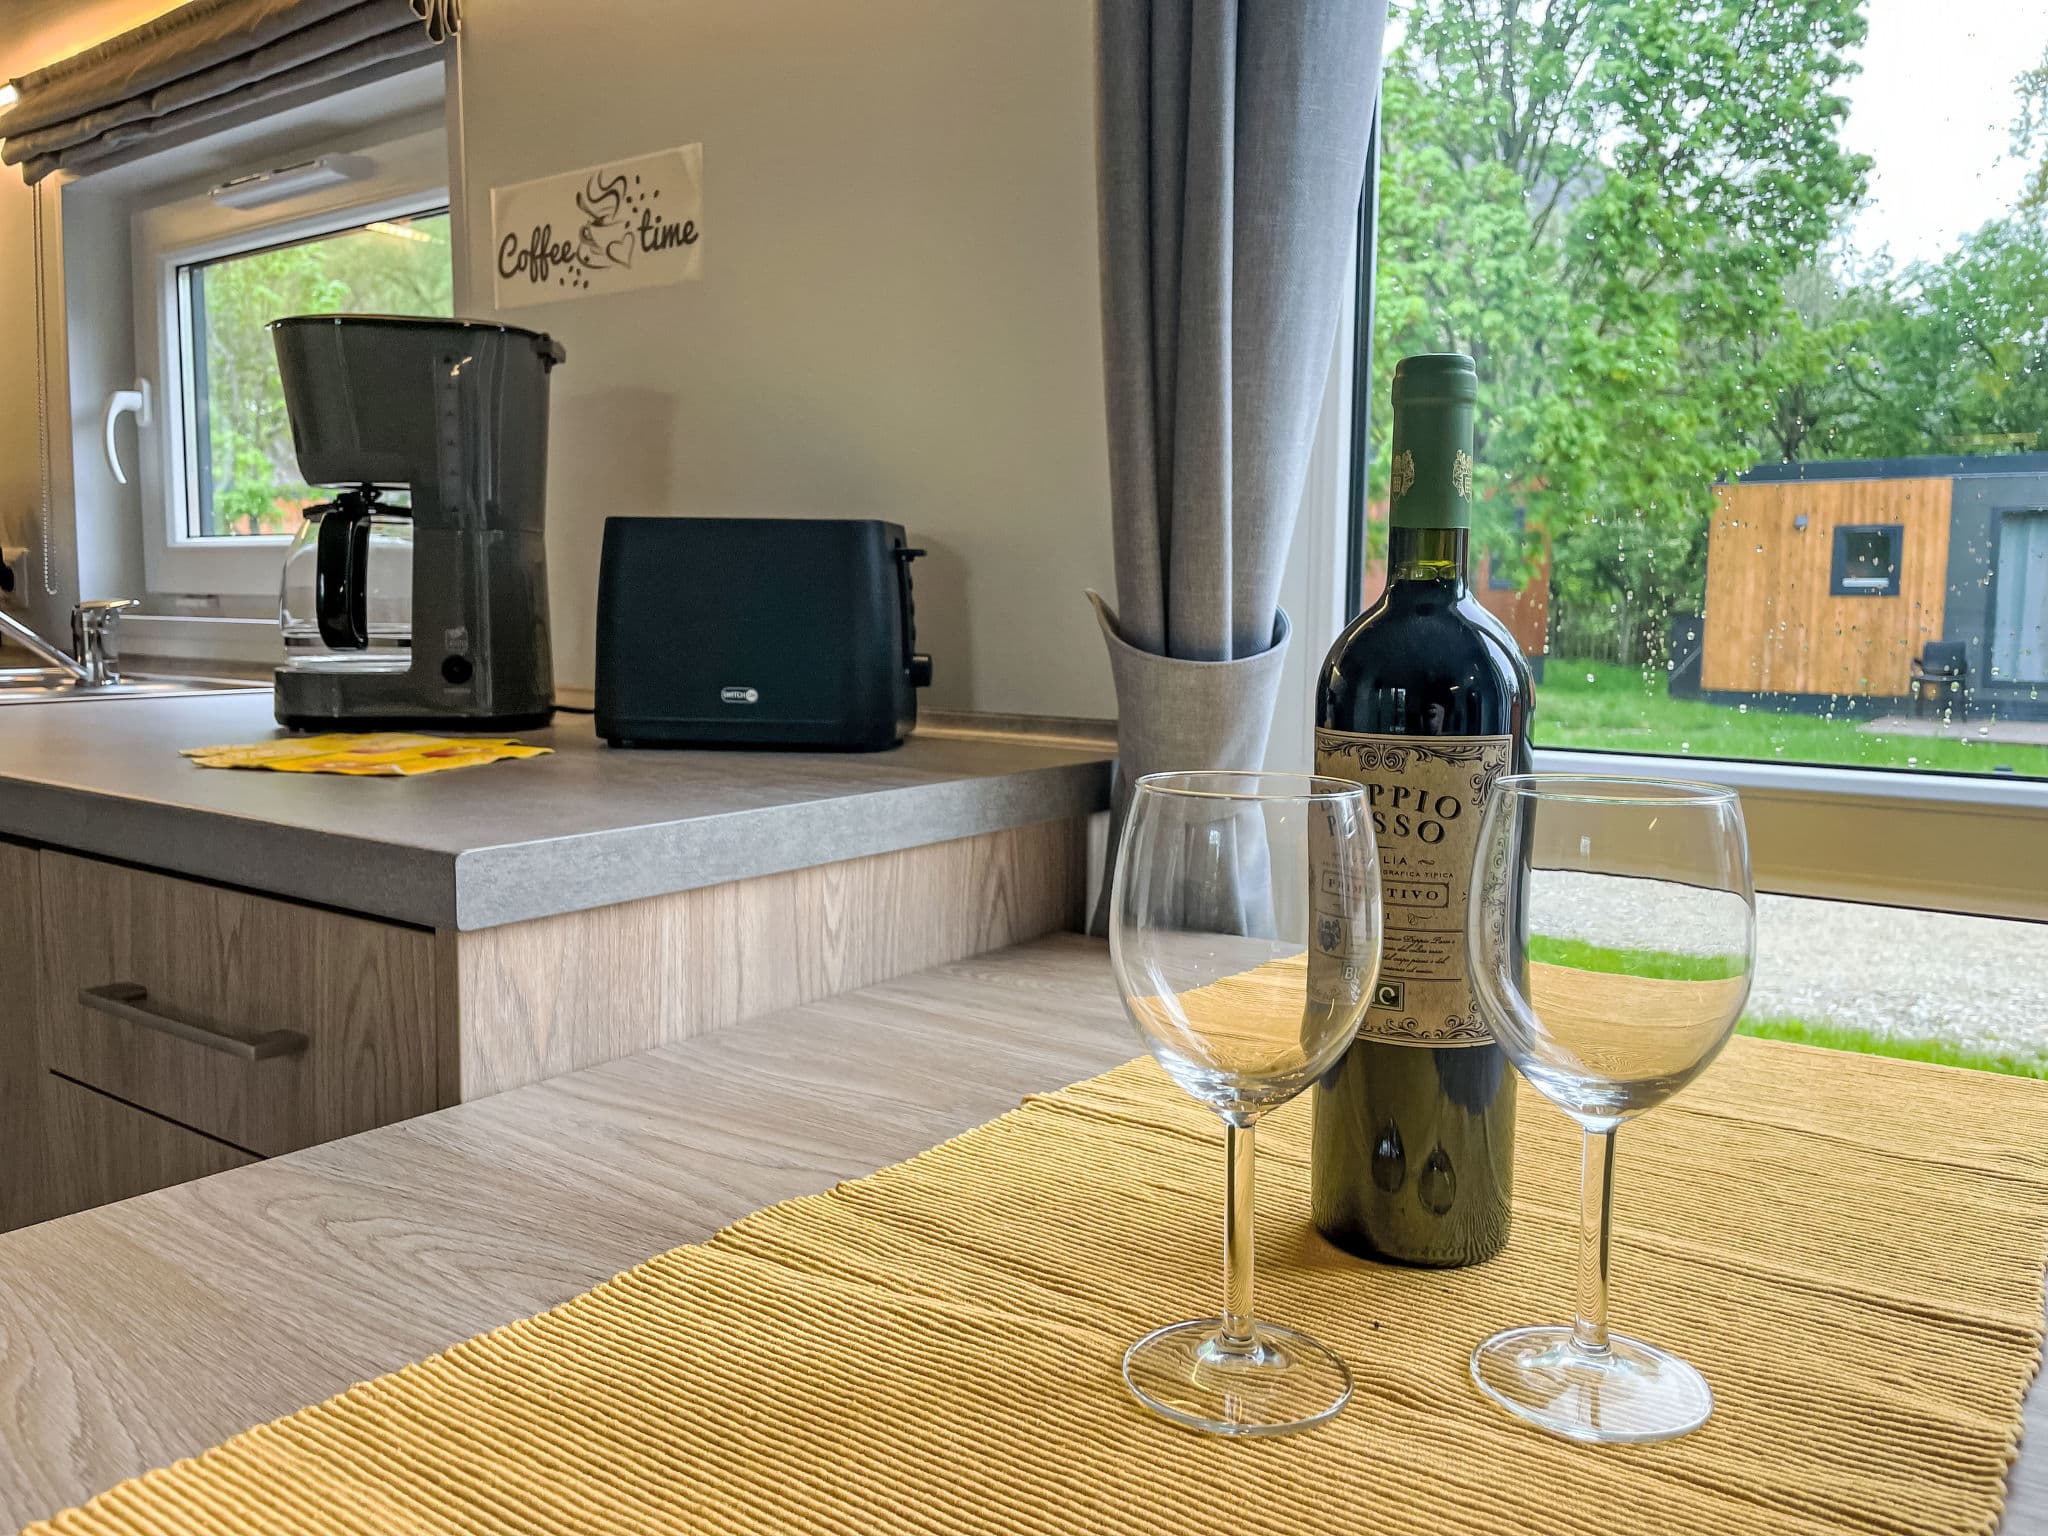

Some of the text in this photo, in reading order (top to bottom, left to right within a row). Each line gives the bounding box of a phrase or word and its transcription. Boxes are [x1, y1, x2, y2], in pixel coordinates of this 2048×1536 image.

[498, 208, 699, 284] Coffee time
[1328, 810, 1446, 845] PSSO
